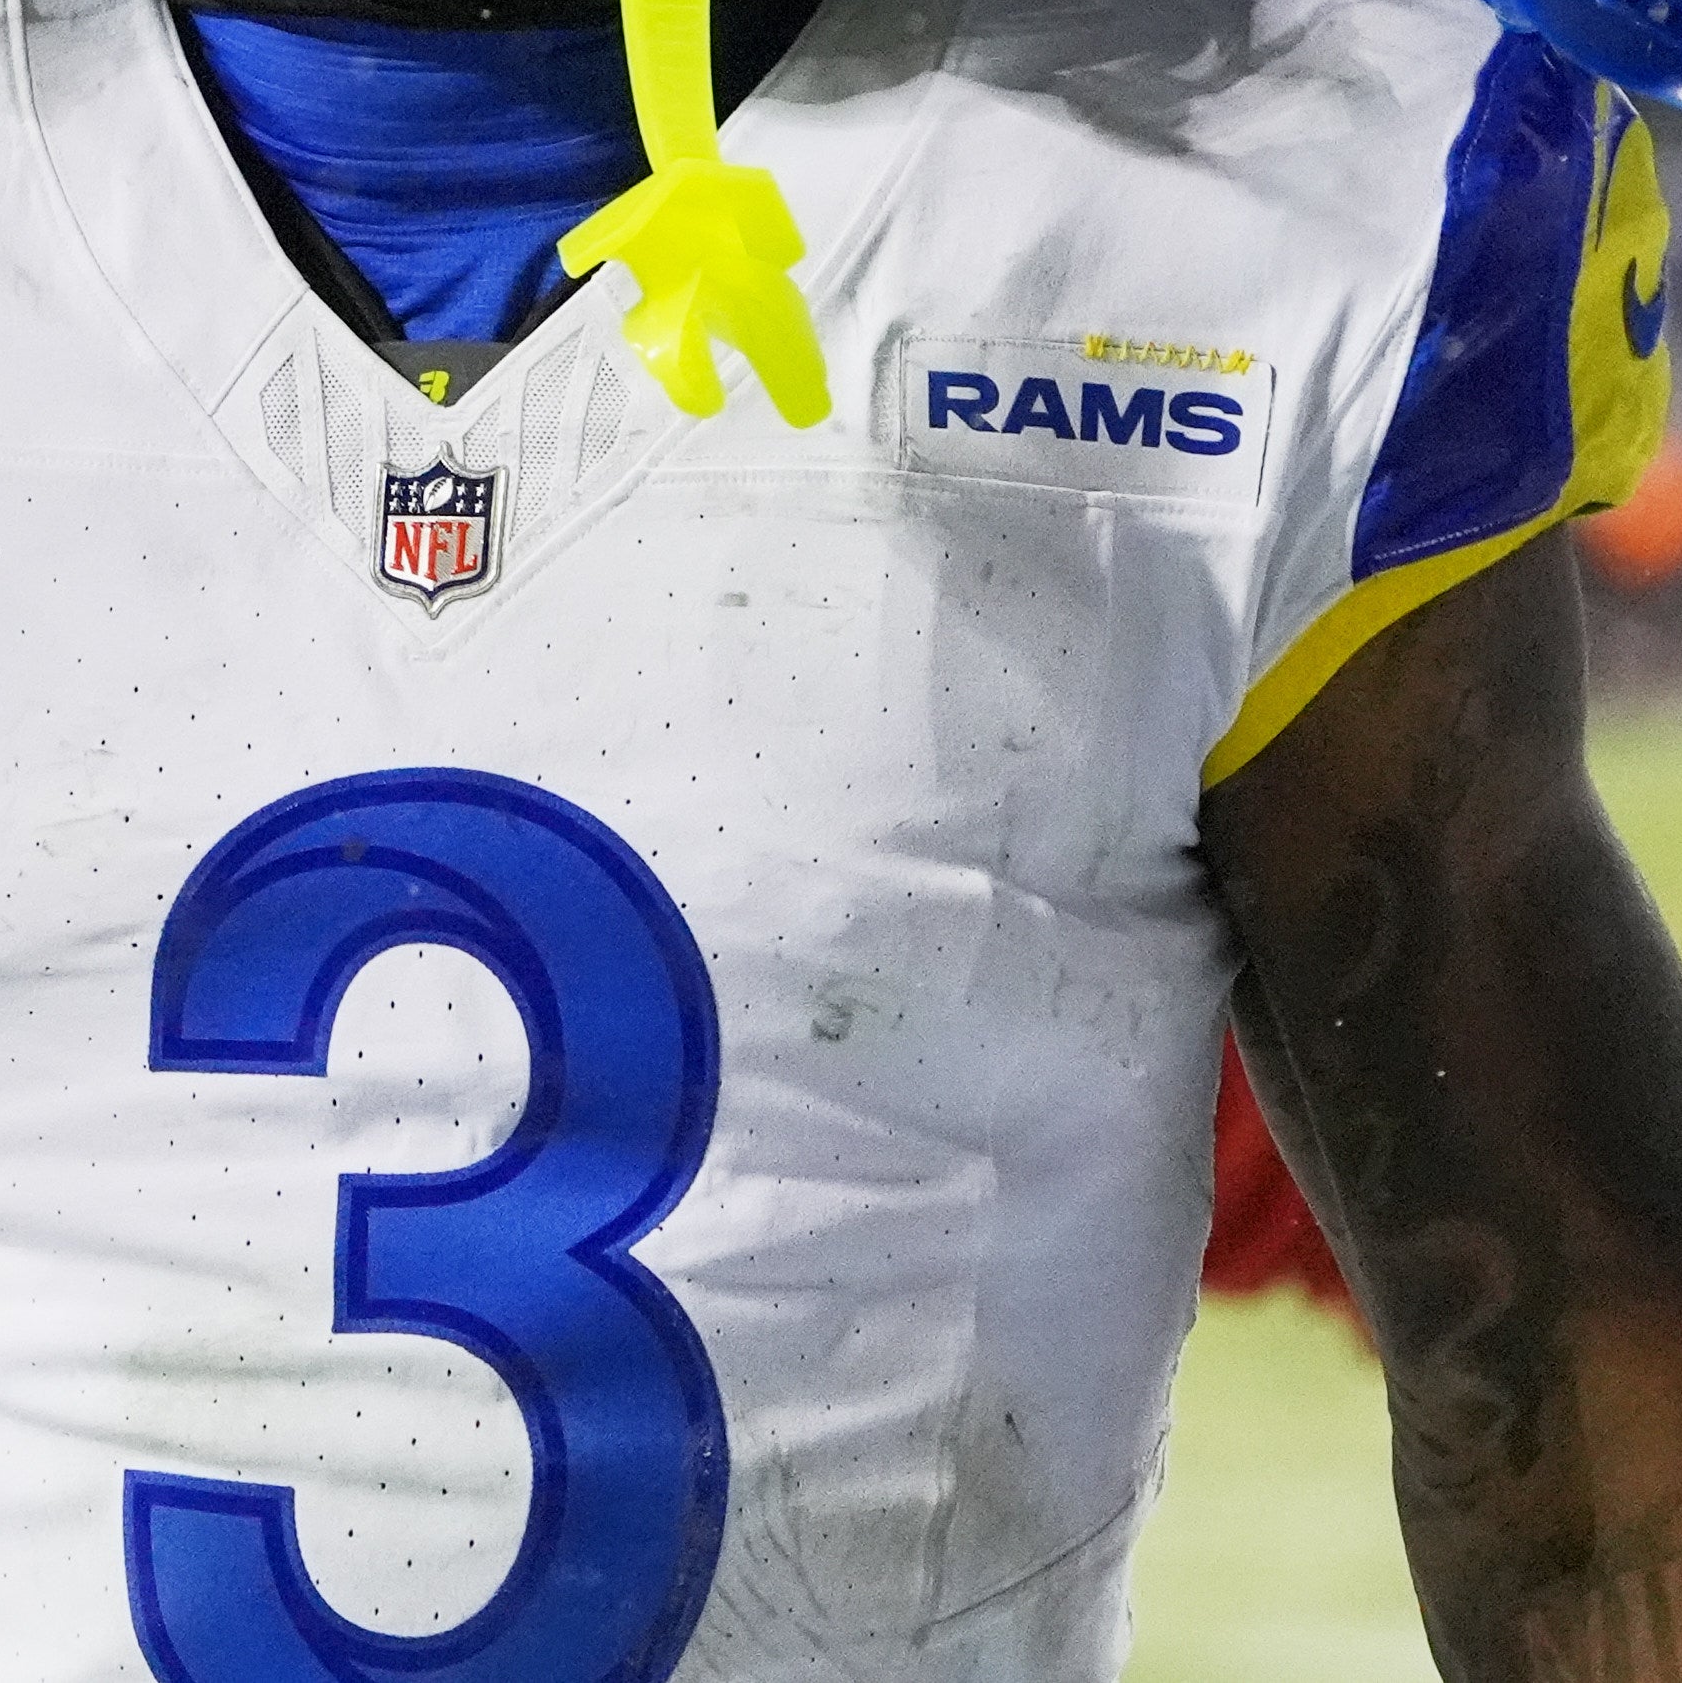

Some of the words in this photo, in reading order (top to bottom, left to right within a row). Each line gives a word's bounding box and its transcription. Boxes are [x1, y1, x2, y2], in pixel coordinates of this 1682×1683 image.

[927, 370, 1244, 456] RAMS
[391, 521, 478, 582] NFL
[123, 766, 730, 1683] 3
